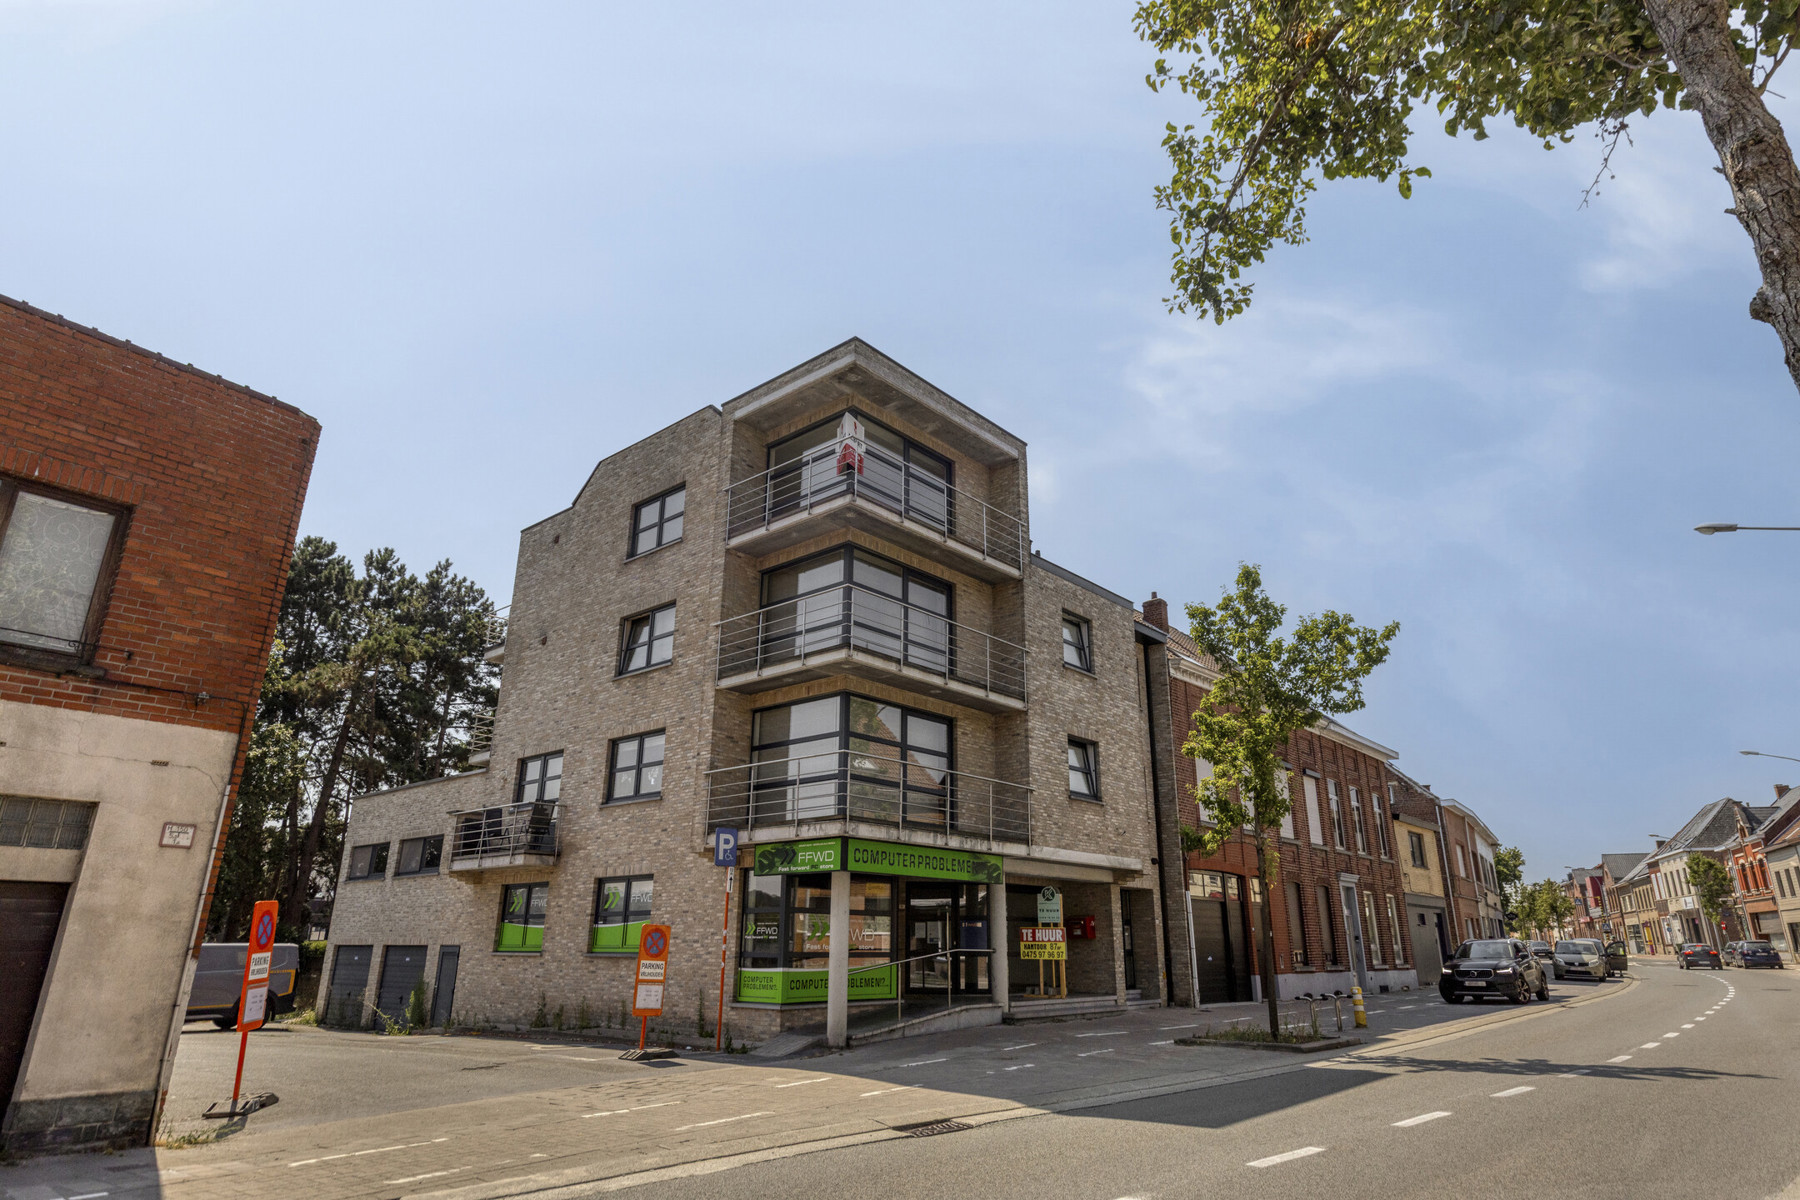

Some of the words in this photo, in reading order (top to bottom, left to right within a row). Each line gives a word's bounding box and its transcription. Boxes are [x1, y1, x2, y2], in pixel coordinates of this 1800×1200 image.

[718, 833, 735, 860] P
[798, 850, 835, 864] FFWD
[756, 926, 779, 935] FFWD
[850, 928, 874, 941] WD
[1022, 929, 1032, 941] TE
[1036, 929, 1062, 942] HUUR
[641, 962, 664, 970] PARKING
[790, 978, 828, 990] COMPUTE
